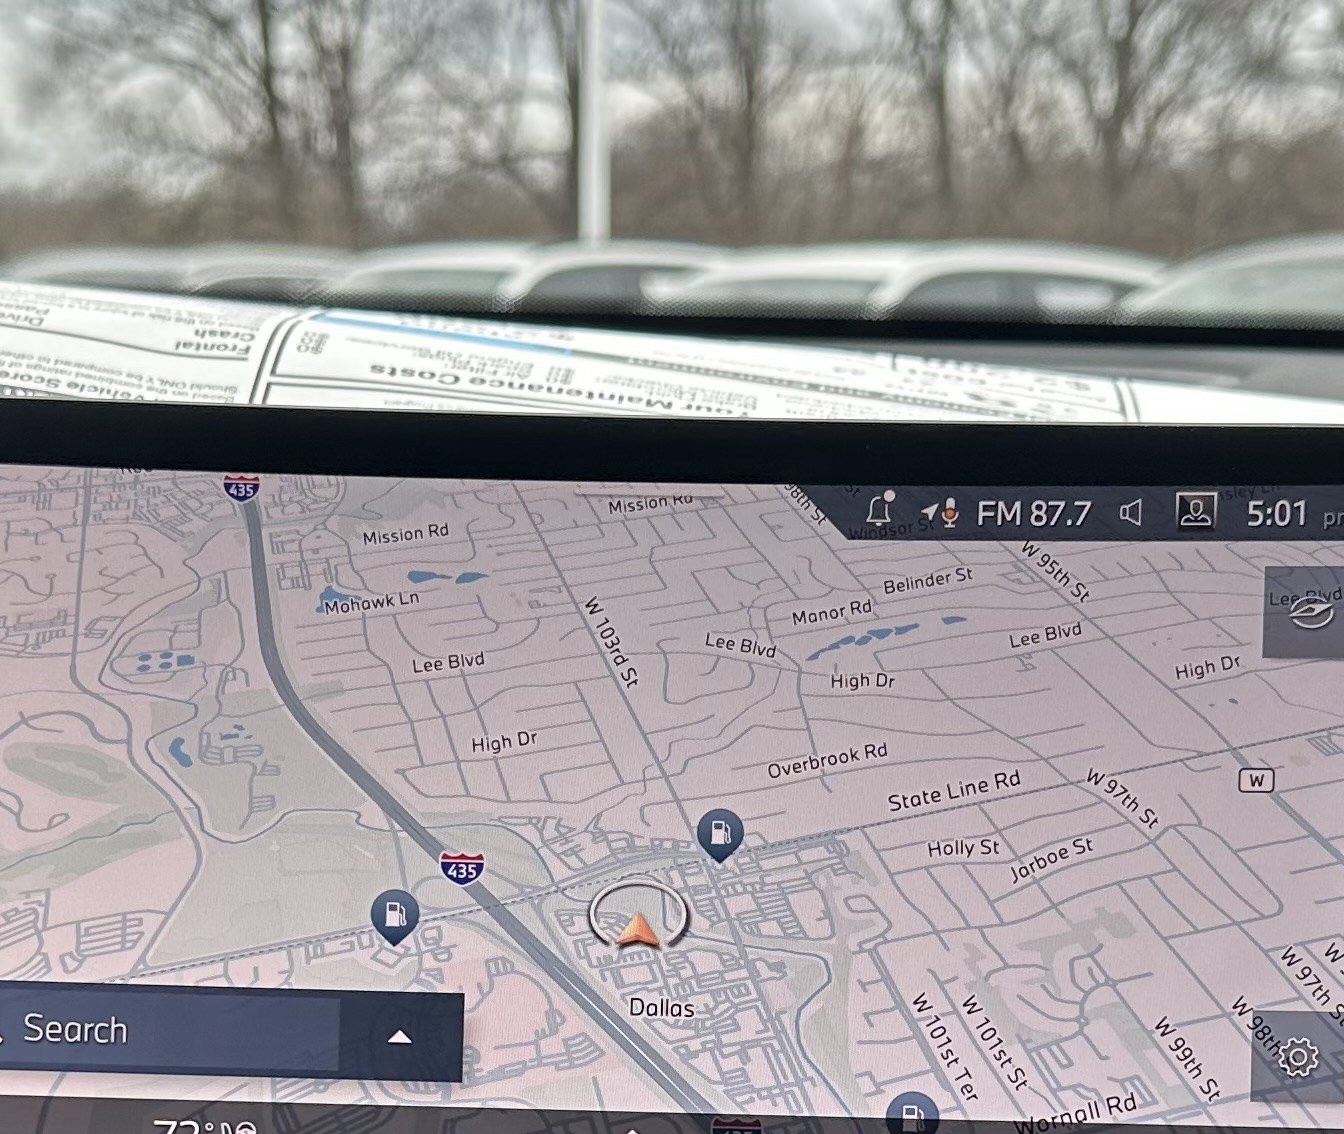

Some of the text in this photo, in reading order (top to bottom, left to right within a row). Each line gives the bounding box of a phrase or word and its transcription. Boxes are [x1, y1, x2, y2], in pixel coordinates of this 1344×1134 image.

[175, 340, 251, 356] Frontal
[194, 327, 256, 342] Crash
[370, 364, 460, 386] Costs
[469, 376, 673, 410] Maintenance
[229, 484, 254, 497] 435
[608, 497, 668, 515] Mission
[977, 500, 1092, 527] FM 87.7
[1248, 499, 1306, 527] 5:01
[362, 522, 449, 546] Mission Rd
[883, 567, 974, 595] Belinder St
[1020, 541, 1091, 603] W 95th St
[325, 591, 419, 615] Mohawk Ln
[791, 599, 873, 626] Manor Rd
[584, 595, 640, 690] W 103rd St
[705, 632, 777, 659] Lee Blvd
[1009, 621, 1083, 649] Lee Blvd
[412, 651, 485, 674] Lee Blvd
[1175, 655, 1241, 681] High Dr
[830, 673, 895, 692] High Dr
[472, 731, 538, 755] High Dr
[767, 743, 888, 780] Overbrook Rd
[887, 770, 1021, 813] State Line Rd
[1249, 774, 1265, 788] W
[1086, 768, 1159, 830] W 97th St
[927, 838, 1000, 858] Holly St
[1010, 838, 1093, 884] Jarboe St
[447, 863, 477, 879] 435
[1281, 946, 1302, 967] W
[1296, 966, 1330, 1006] 97th
[629, 997, 695, 1019] Dallas
[23, 1013, 128, 1045] Search
[1232, 996, 1282, 1058] W 98th
[913, 992, 979, 1102] W 101st Ter
[962, 994, 1029, 1092] W 101st St
[1155, 1016, 1221, 1102] W 99th St
[1107, 1092, 1137, 1116] Rd
